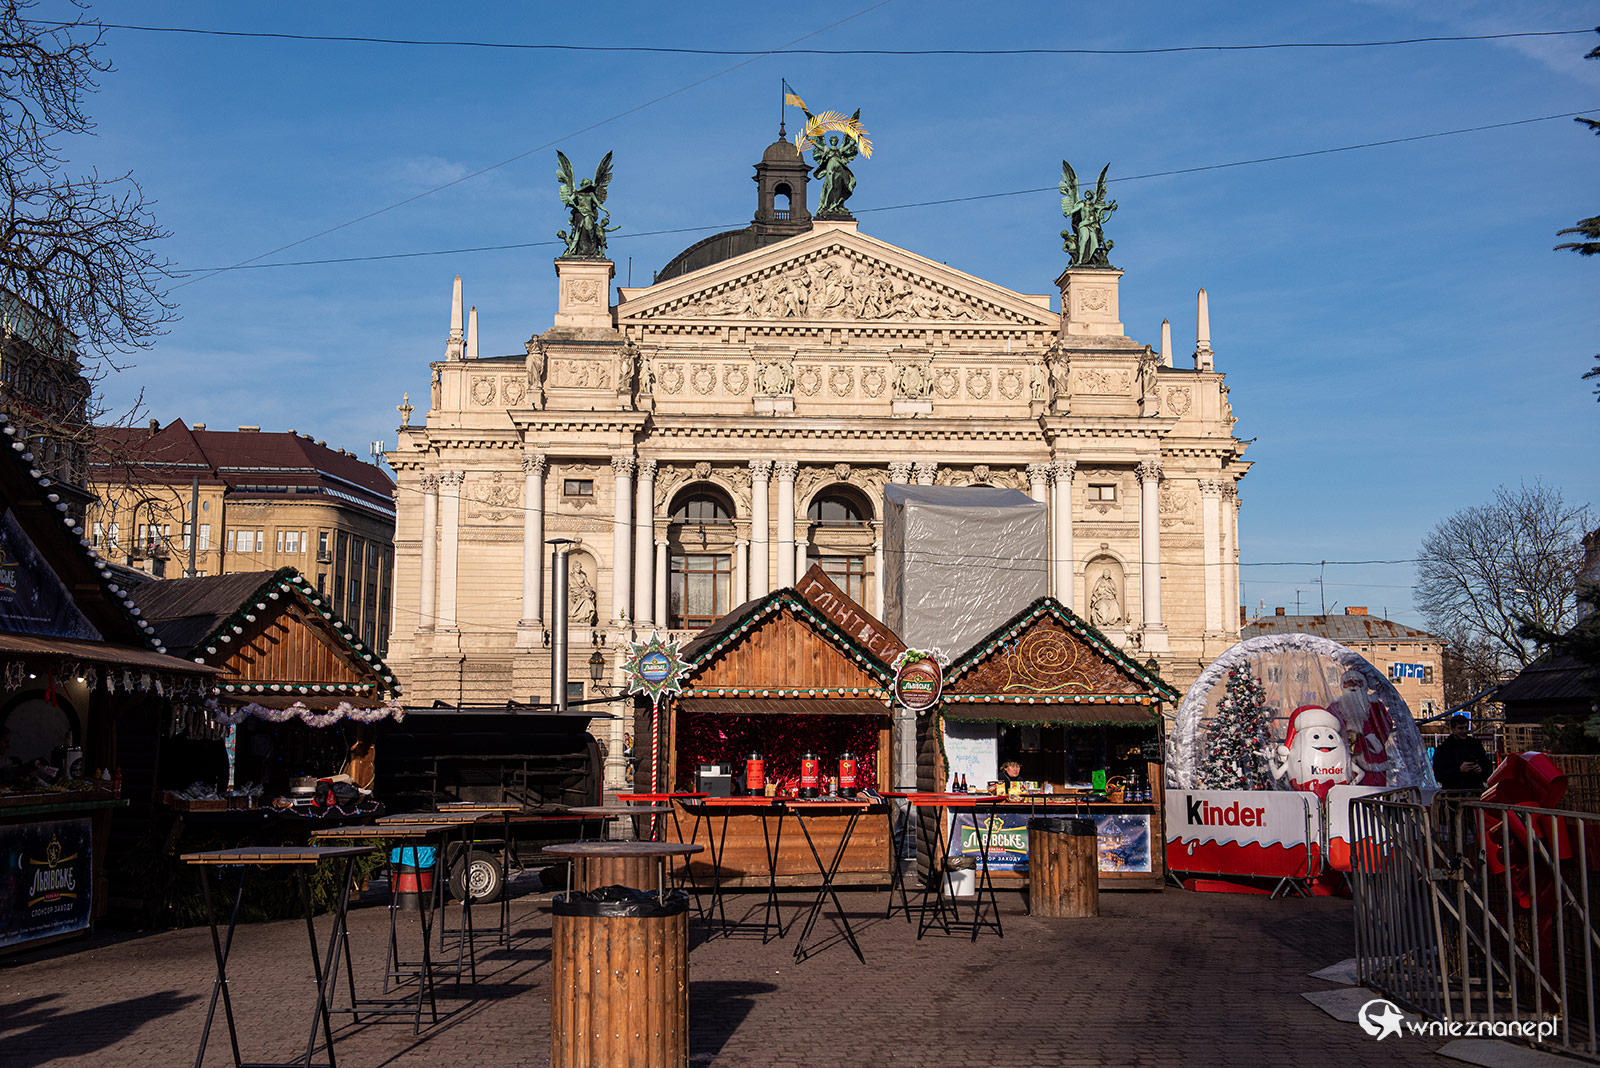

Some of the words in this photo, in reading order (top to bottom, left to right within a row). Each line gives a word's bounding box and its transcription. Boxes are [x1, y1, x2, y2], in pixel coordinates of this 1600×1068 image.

[803, 578, 900, 663] ГЛІНТВЕЙ
[1186, 795, 1265, 827] Kinder
[29, 867, 76, 897] ЛЬВІВСЬКЕ
